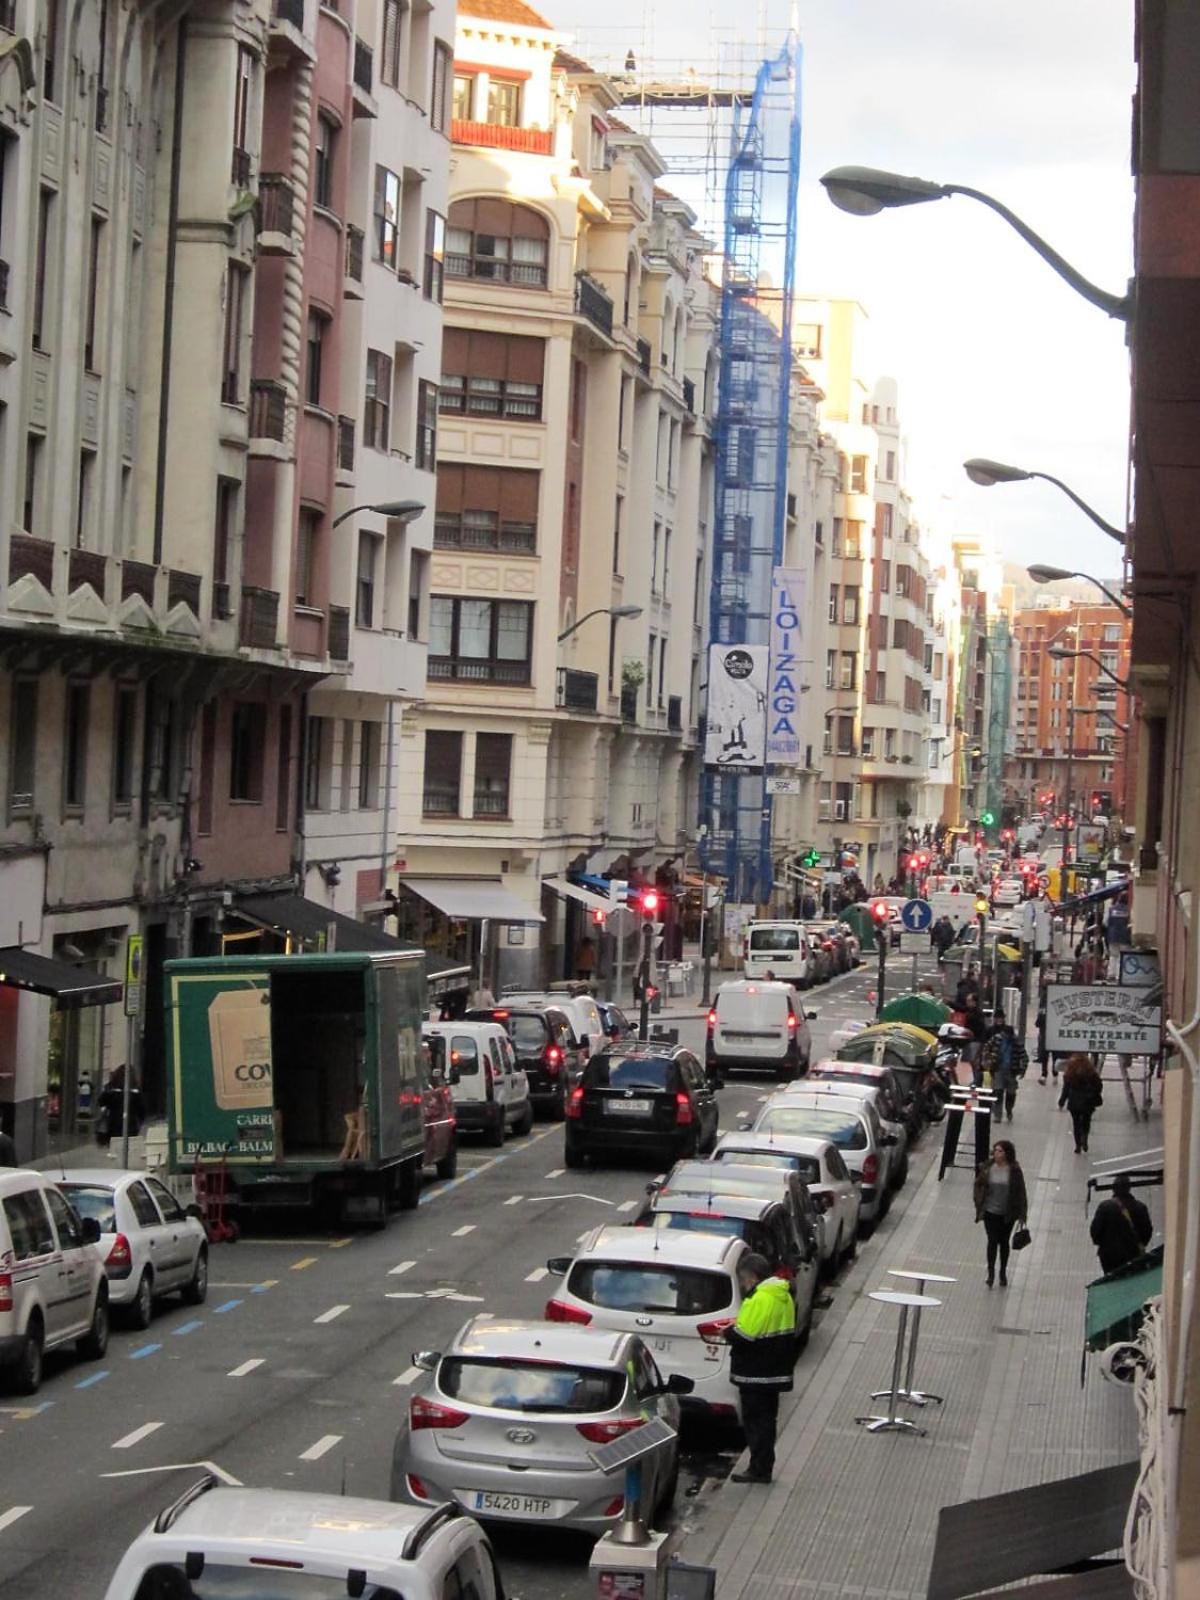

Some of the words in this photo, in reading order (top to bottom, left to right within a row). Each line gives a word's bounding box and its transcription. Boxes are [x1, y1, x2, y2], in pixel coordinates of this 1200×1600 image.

[773, 590, 799, 735] LOIZAGA
[485, 1495, 520, 1511] 5420
[524, 1499, 550, 1514] HTP
